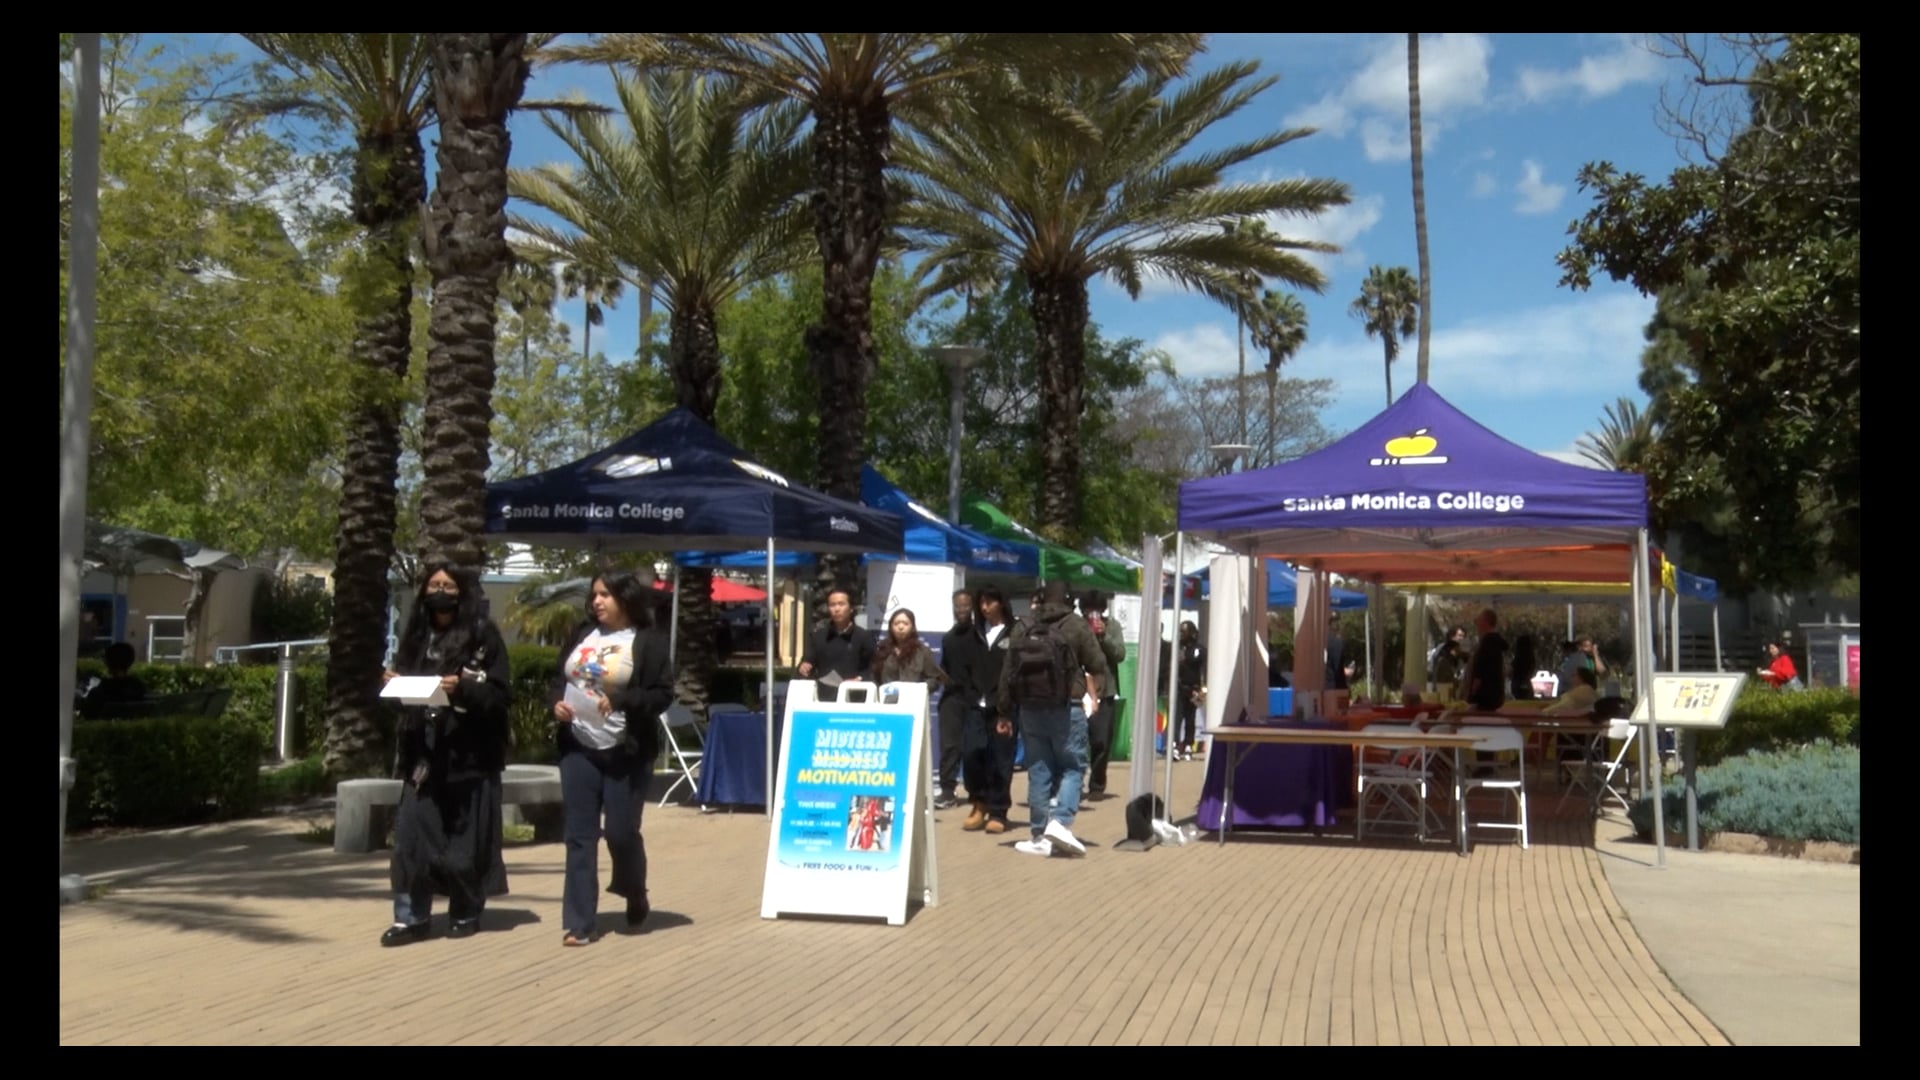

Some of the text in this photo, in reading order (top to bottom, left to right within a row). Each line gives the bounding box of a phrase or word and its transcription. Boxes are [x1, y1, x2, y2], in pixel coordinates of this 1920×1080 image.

[1283, 491, 1525, 512] Santa Monica College
[502, 503, 685, 521] Santa Monica College
[815, 729, 892, 750] MIDTERM
[797, 768, 896, 787] MOTIVATION
[803, 862, 822, 870] FREE
[823, 862, 846, 871] FOOD
[855, 864, 873, 872] FUN
